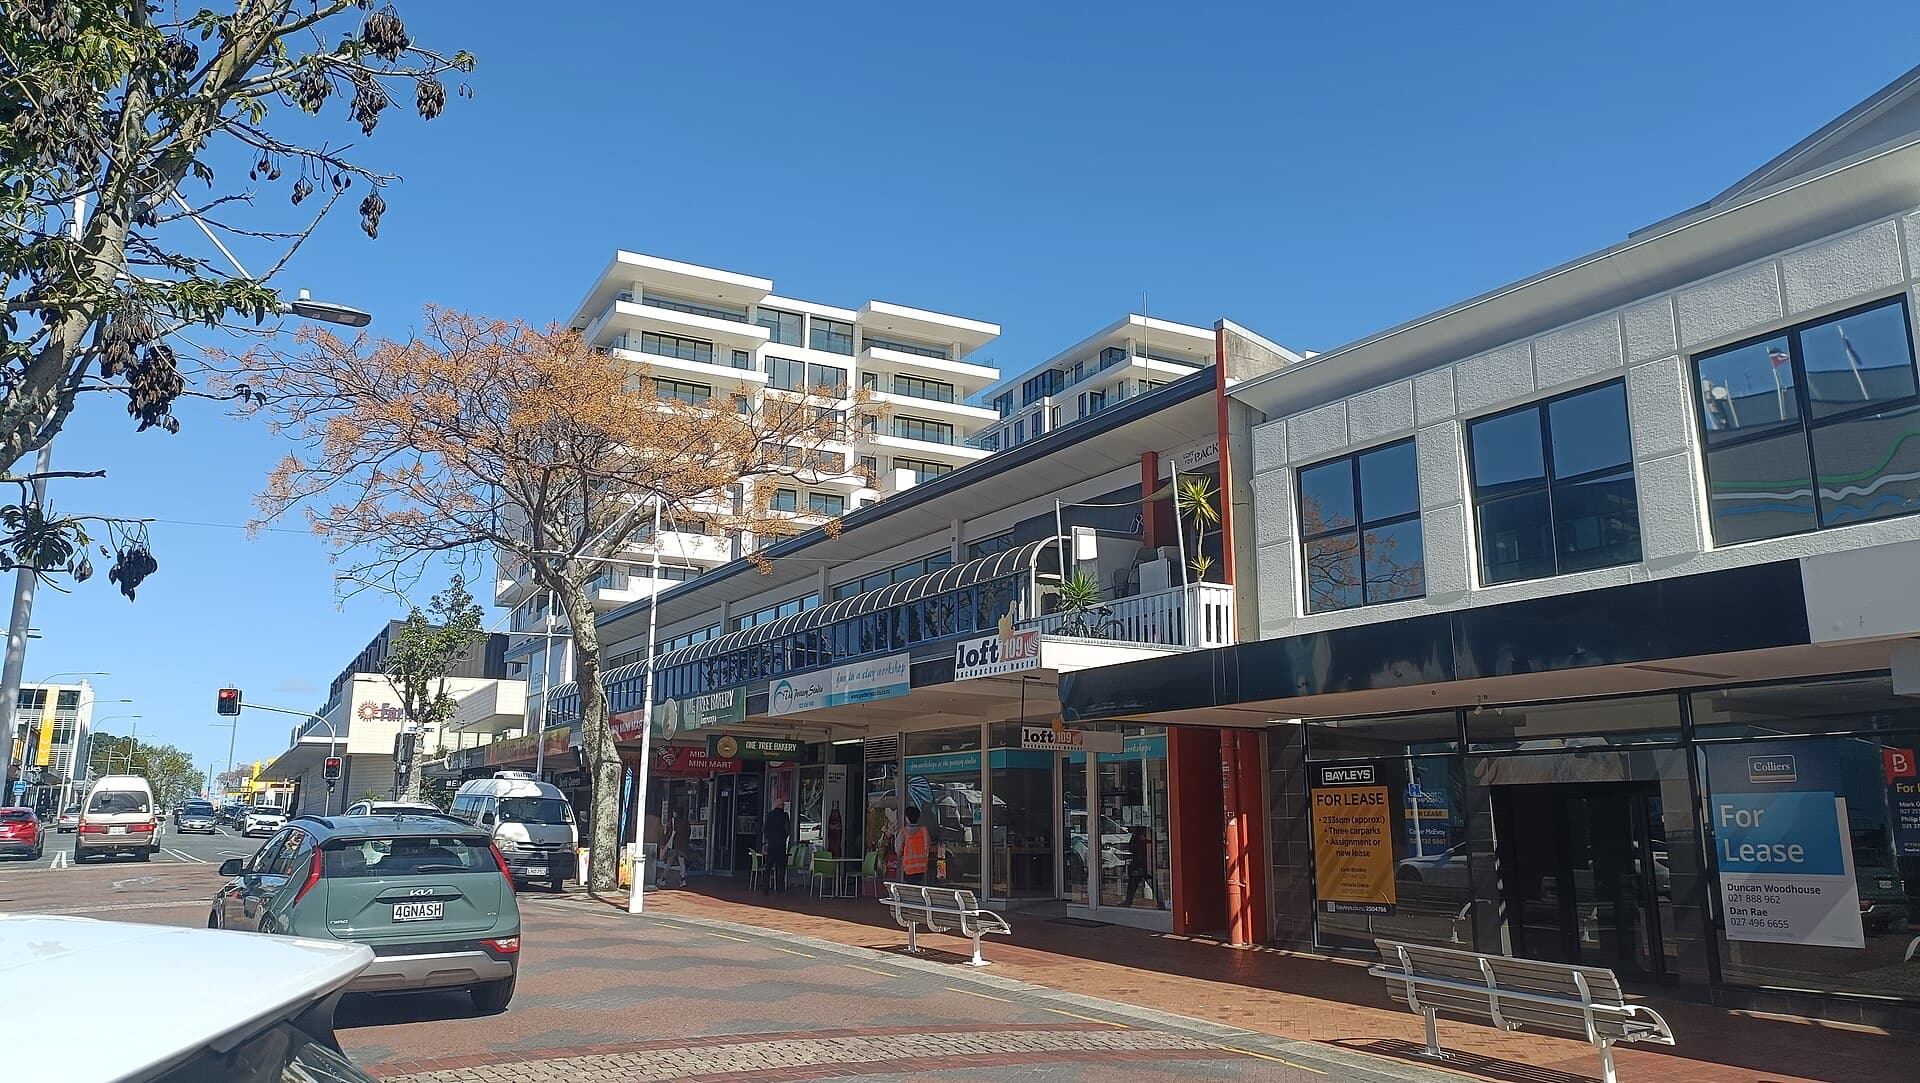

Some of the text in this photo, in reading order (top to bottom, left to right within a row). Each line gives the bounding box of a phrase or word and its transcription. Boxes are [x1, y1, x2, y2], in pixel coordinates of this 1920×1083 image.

[956, 638, 999, 670] loft
[711, 689, 734, 711] BAKERY
[1023, 729, 1055, 743] loft
[745, 740, 797, 752] ONE TREE BAKERY
[688, 760, 733, 769] MINI MART
[1753, 761, 1791, 772] Colliers
[1325, 769, 1371, 781] BAYLEYS
[1896, 783, 1915, 793] For
[1316, 792, 1384, 806] FOR LEASE
[1720, 804, 1764, 828] For
[1328, 826, 1381, 836] Three carparks
[1330, 837, 1372, 847] Assignment
[1351, 849, 1371, 857] lease
[1724, 838, 1804, 863] Lease
[1727, 883, 1821, 894] Duncan Woodhouse
[1728, 893, 1781, 905] 021 888 962
[395, 904, 442, 918] 4GNASH
[1729, 906, 1768, 917] Dan Rae
[1730, 917, 1789, 929] 027 496 6655
